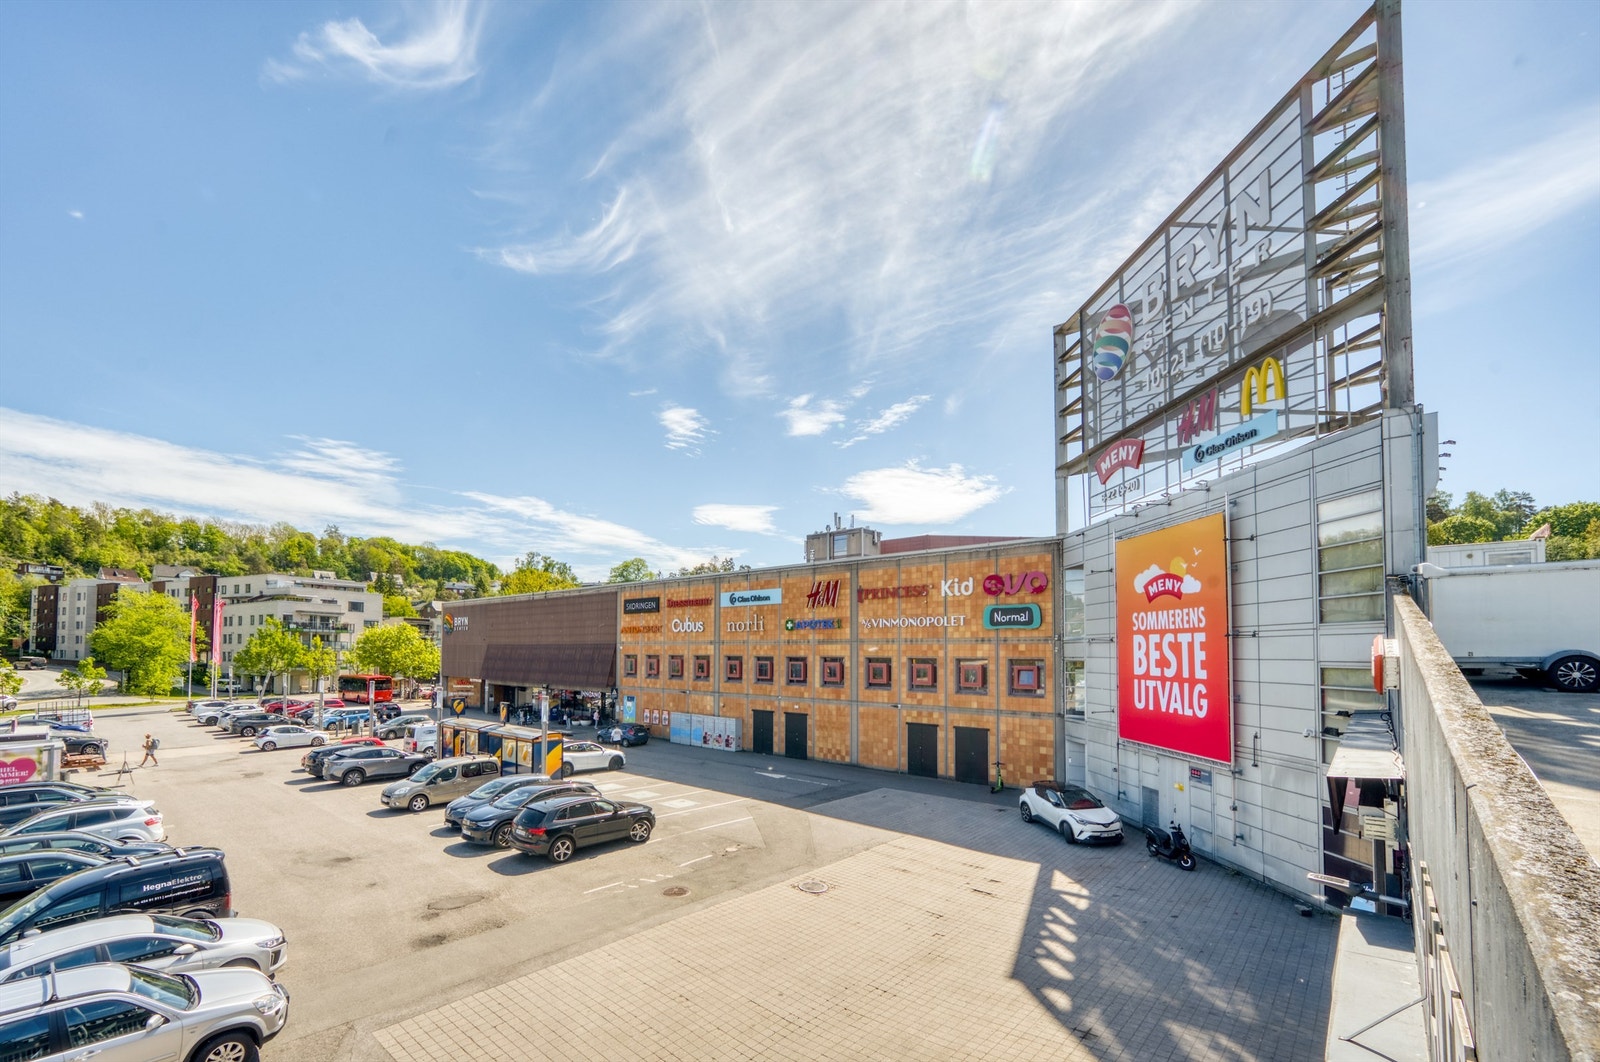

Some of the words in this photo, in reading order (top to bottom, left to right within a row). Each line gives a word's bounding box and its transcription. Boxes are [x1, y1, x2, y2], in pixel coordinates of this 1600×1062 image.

[1142, 168, 1272, 326] BRYN
[1141, 238, 1272, 351] SENTER
[1146, 348, 1188, 392] 10-21
[1177, 389, 1218, 446] H&M
[1206, 443, 1225, 456] Clas
[1225, 429, 1258, 448] Ohlson
[1100, 445, 1137, 475] MENY
[806, 579, 841, 609] H&M
[863, 584, 929, 600] PRINCESS
[941, 577, 974, 597] Kid
[1148, 578, 1182, 597] MENY
[454, 616, 469, 626] BRYN
[671, 617, 705, 633] Cubus
[727, 614, 765, 632] norli
[794, 619, 835, 630] APOTEK
[836, 618, 842, 629] 1
[872, 615, 966, 629] VINMONOPOLET
[994, 610, 1029, 623] Normal
[1132, 606, 1206, 631] SOMMERENS
[1132, 632, 1208, 680] BESTE
[1133, 679, 1208, 719] UTVALG
[143, 874, 202, 892] HegnaElektro
